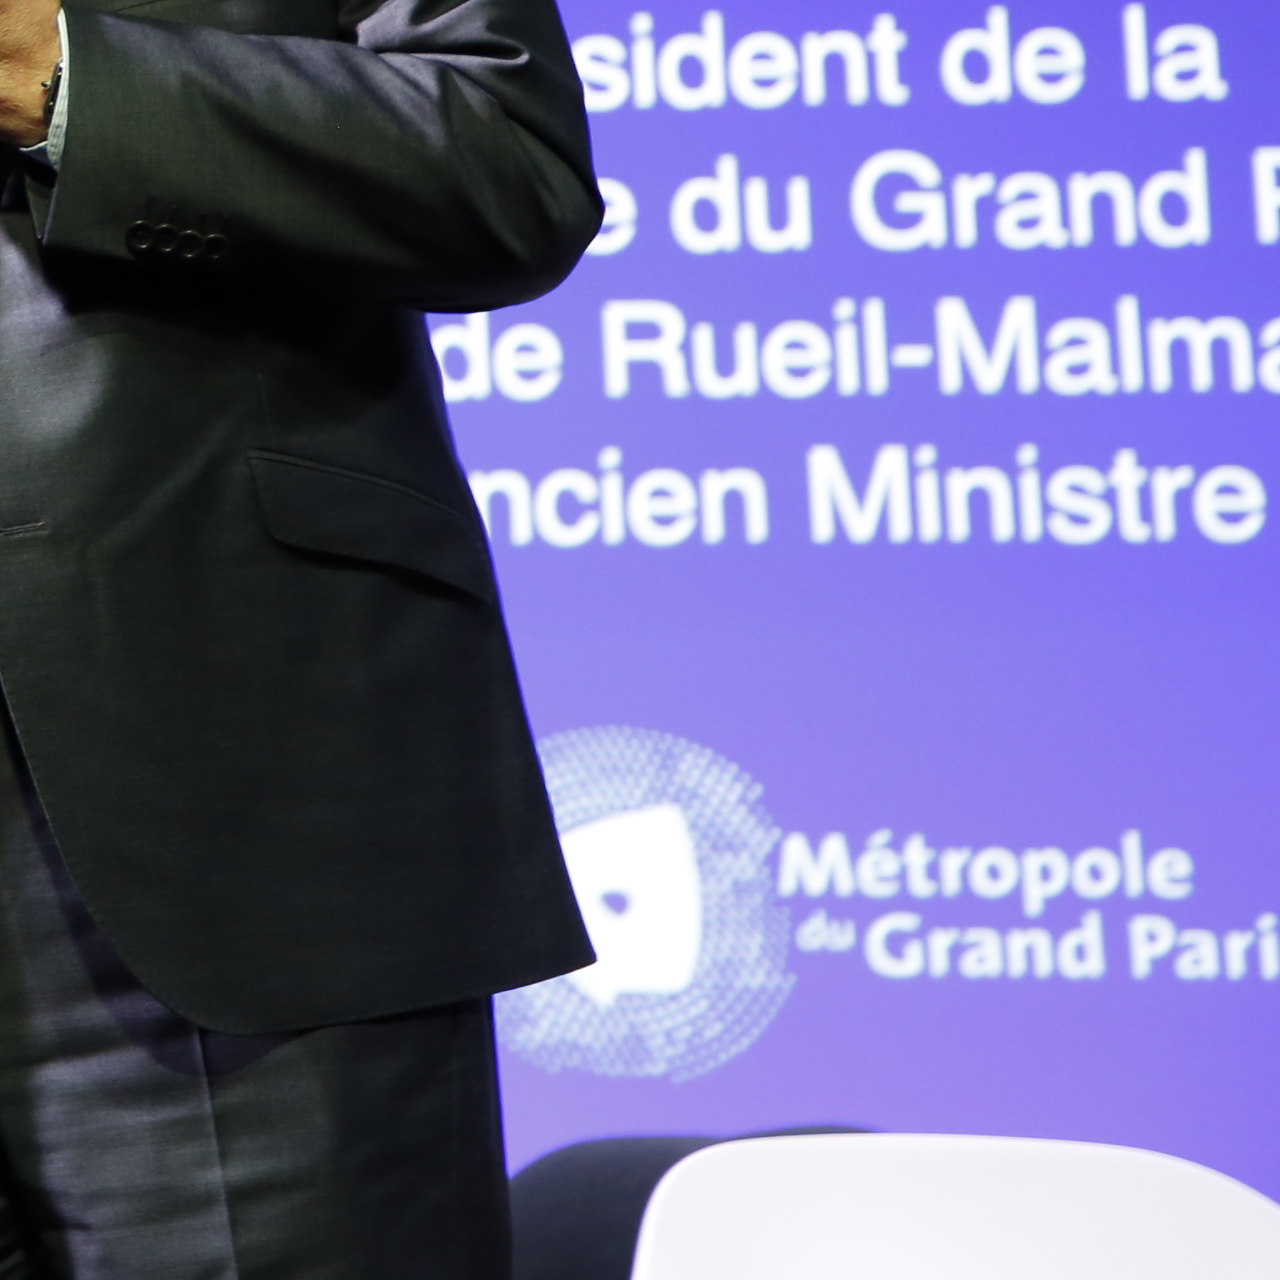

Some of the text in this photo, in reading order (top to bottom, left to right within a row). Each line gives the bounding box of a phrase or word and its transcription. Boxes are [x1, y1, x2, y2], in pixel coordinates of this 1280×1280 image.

[940, 5, 1086, 105] de
[1123, 3, 1228, 101] la
[669, 153, 812, 254] du
[849, 147, 1211, 251] Grand
[431, 311, 564, 402] de
[806, 443, 1266, 545] Ministre
[777, 828, 1193, 919] Métropole
[794, 908, 857, 952] du
[864, 908, 1106, 979] Grand
